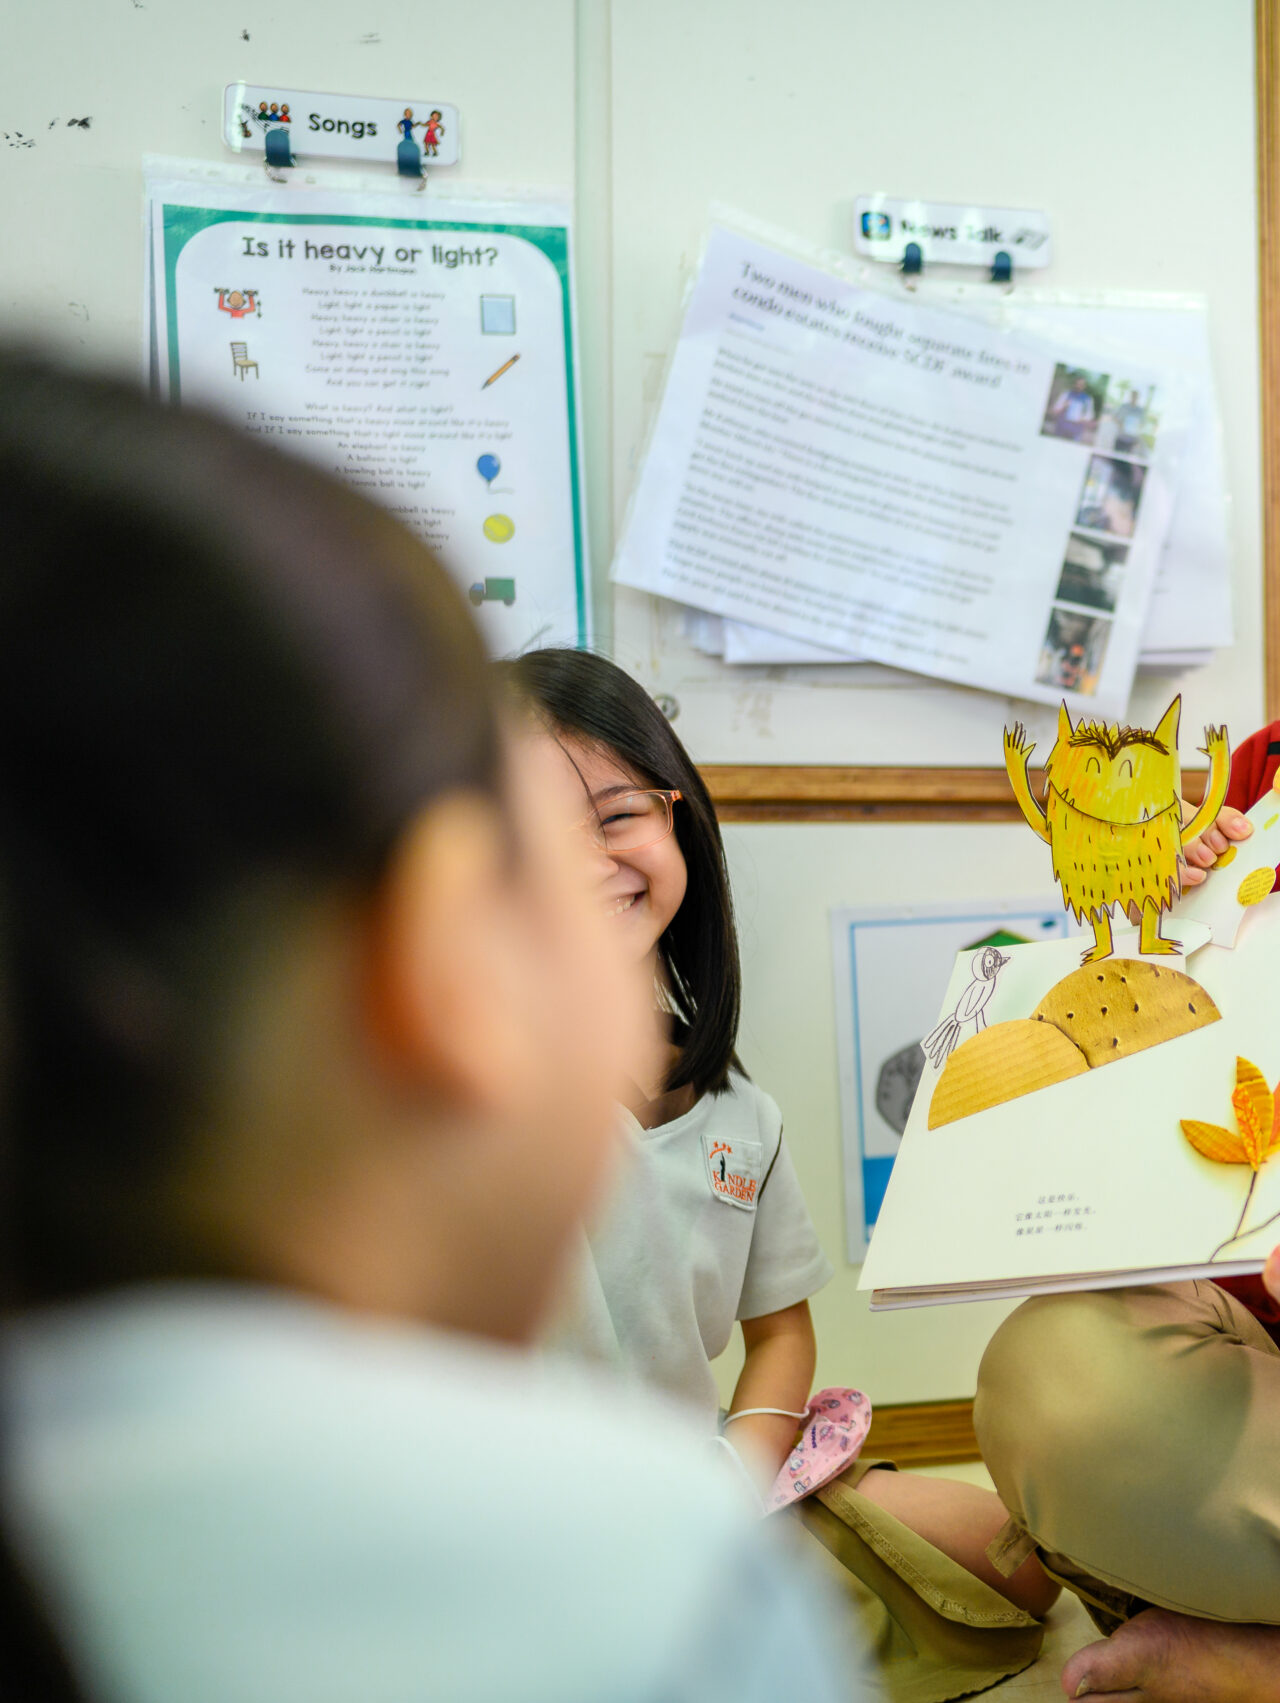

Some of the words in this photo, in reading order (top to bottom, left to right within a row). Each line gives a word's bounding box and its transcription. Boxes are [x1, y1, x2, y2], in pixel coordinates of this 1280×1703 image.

[308, 113, 378, 139] Songs
[901, 219, 958, 242] News
[242, 236, 269, 257] Is
[278, 239, 296, 259] it
[305, 239, 385, 265] heavy
[395, 244, 422, 263] or
[432, 243, 498, 269] light?
[731, 287, 784, 317] condo
[741, 260, 776, 289] Two
[777, 280, 814, 307] men
[815, 296, 850, 320] who
[714, 1182, 756, 1202] GARDEN
